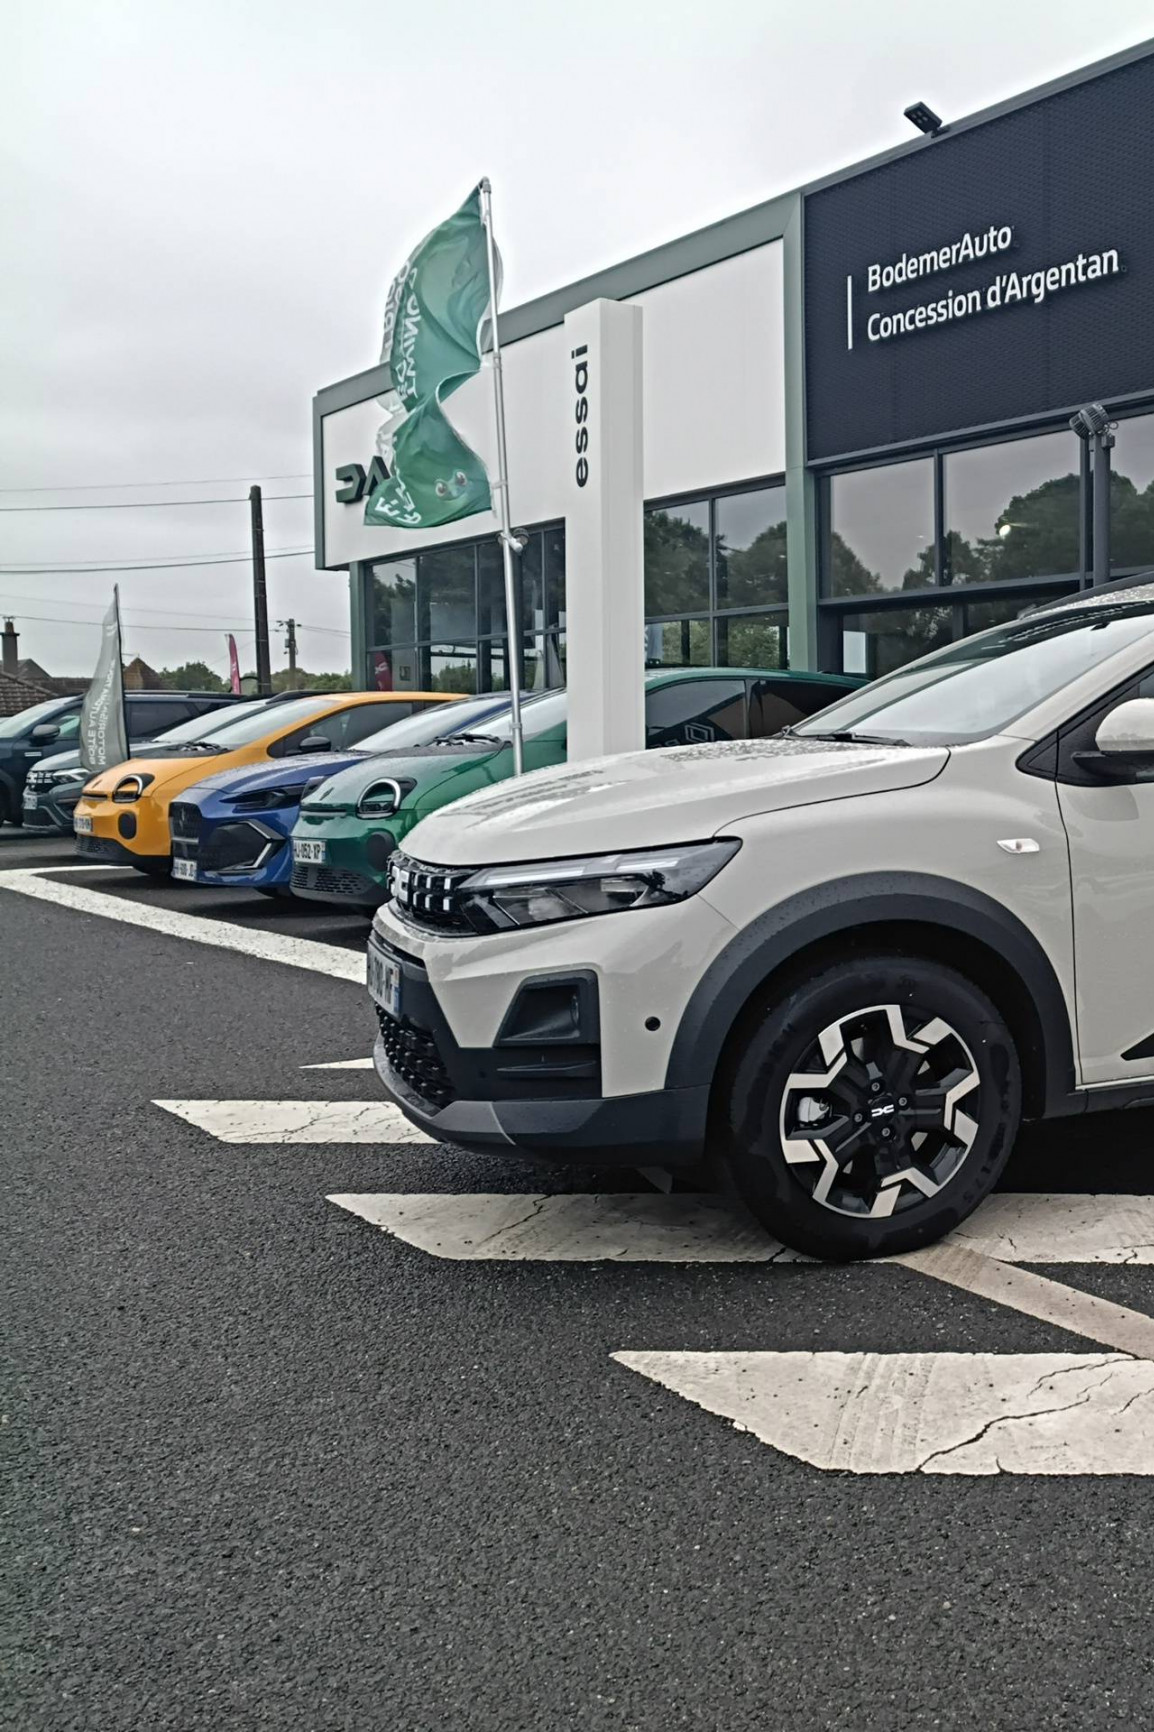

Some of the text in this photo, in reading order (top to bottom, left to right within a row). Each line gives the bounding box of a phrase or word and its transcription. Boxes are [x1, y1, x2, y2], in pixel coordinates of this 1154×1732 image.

[867, 225, 1012, 292] BodemerAuto
[867, 248, 1119, 342] Concession d'Argentan
[571, 344, 589, 488] essai
